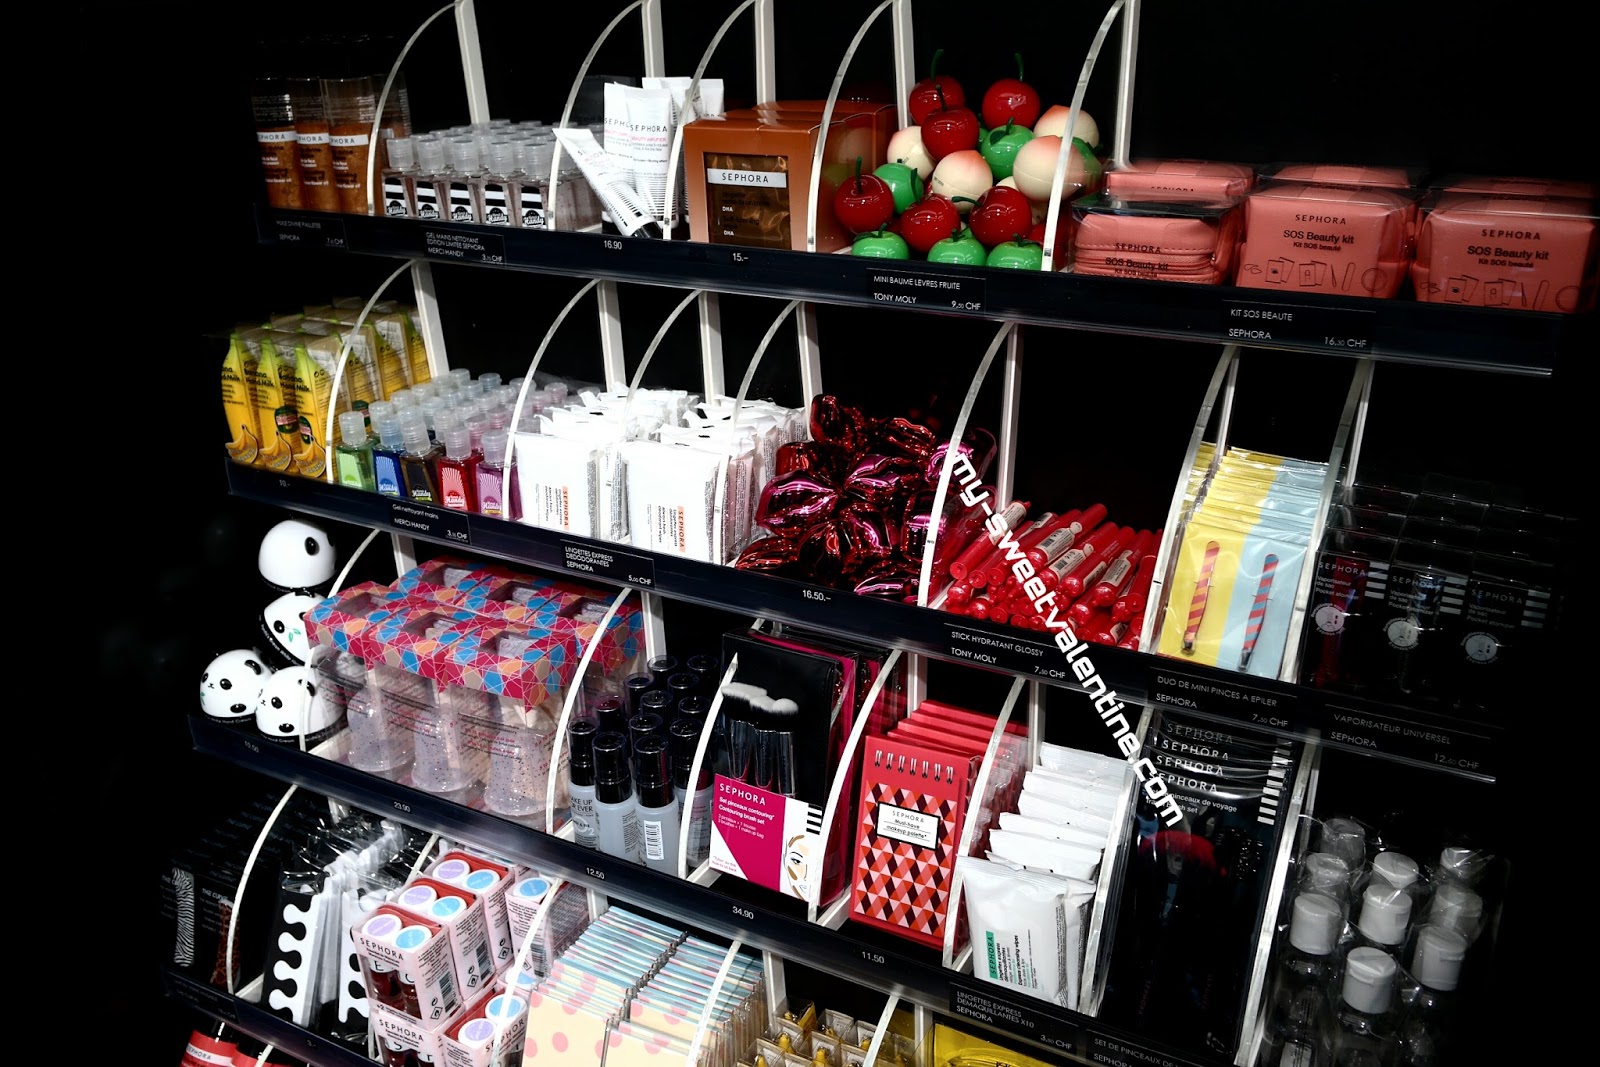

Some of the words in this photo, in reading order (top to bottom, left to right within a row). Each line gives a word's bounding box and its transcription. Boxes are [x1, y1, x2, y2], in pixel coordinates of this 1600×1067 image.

[630, 124, 668, 132] SEPHORA
[721, 172, 769, 184] SEPHORA
[1295, 214, 1347, 225] SEPHORA
[1283, 230, 1304, 239] SOS
[1306, 232, 1339, 244] Beauty
[1342, 235, 1355, 244] kit
[1482, 229, 1541, 240] SEPHORA
[463, 243, 485, 251] SEPHORA
[603, 239, 623, 250] 16.90
[1115, 242, 1161, 254] SEPHORA
[1467, 246, 1491, 256] SOS
[1494, 248, 1533, 260] Beauty
[1535, 251, 1549, 260] kit
[1105, 257, 1124, 266] SOS
[1126, 259, 1156, 271] Beauty
[1158, 262, 1169, 270] kit
[890, 277, 913, 286] BAUME
[914, 279, 938, 288] LEVRES
[939, 281, 961, 290] FRUITE
[873, 292, 894, 301] TONY
[895, 295, 917, 304] MOLY
[965, 302, 981, 311] CHF
[1230, 309, 1242, 317] KIT
[1243, 310, 1260, 318] SOS
[1262, 311, 1293, 321] BEAUTE
[1228, 328, 1272, 340] SEPHORA
[1346, 338, 1367, 348] CHF
[392, 503, 401, 511] Gel
[565, 546, 591, 557] LINGETTES
[591, 551, 614, 563] EXPRESS
[566, 560, 594, 572] SEPHORA
[1318, 561, 1366, 576] SEPHORA
[639, 576, 651, 585] CHF
[951, 631, 971, 641] STICK
[971, 635, 1013, 650] HYDRATANT
[1014, 644, 1044, 657] GLOSSY
[951, 647, 972, 659] TONY
[973, 652, 997, 664] MOLY
[1049, 669, 1066, 679] CHF
[1157, 675, 1177, 686] DUO
[1178, 680, 1190, 689] DE
[1190, 683, 1210, 693] MINI
[1211, 687, 1240, 700] PINCES
[1250, 695, 1277, 707] EPILER
[1156, 693, 1198, 709] SEPHORA
[1269, 716, 1289, 727] CHF
[1167, 723, 1233, 743] SEPHORA
[1333, 713, 1401, 734] VAPORISATEUR
[1403, 728, 1451, 745] UNIVERSEL
[1330, 731, 1378, 749] SEPHORA
[1162, 740, 1229, 760] SEPHORA
[1156, 755, 1223, 776] SEPHORA
[1458, 759, 1480, 770] CHF
[719, 783, 766, 806] SEPHORA
[719, 796, 727, 804] Set
[577, 804, 594, 813] EVER
[718, 804, 743, 818] Contouring
[743, 813, 757, 822] brush
[1212, 801, 1237, 813] voyage
[892, 810, 924, 823] SEPHORA
[586, 867, 605, 880] 12.50
[732, 906, 754, 920] 34.90
[360, 937, 404, 960] SEPHORA
[861, 951, 885, 964] 11.50
[987, 937, 996, 975] SEPHORA
[957, 991, 992, 1008] LINGETTES
[993, 1003, 1022, 1018] EXPRESS
[956, 1006, 993, 1023] SEPHORA
[957, 996, 1020, 1023] DEMAQUILLANTES
[1020, 1018, 1035, 1029] X10
[379, 1019, 424, 1042] SEPHORA
[1055, 1039, 1073, 1050] CHF
[1094, 1037, 1107, 1047] SET
[1108, 1042, 1119, 1051] DE
[1120, 1046, 1161, 1065] PINCEAUX
